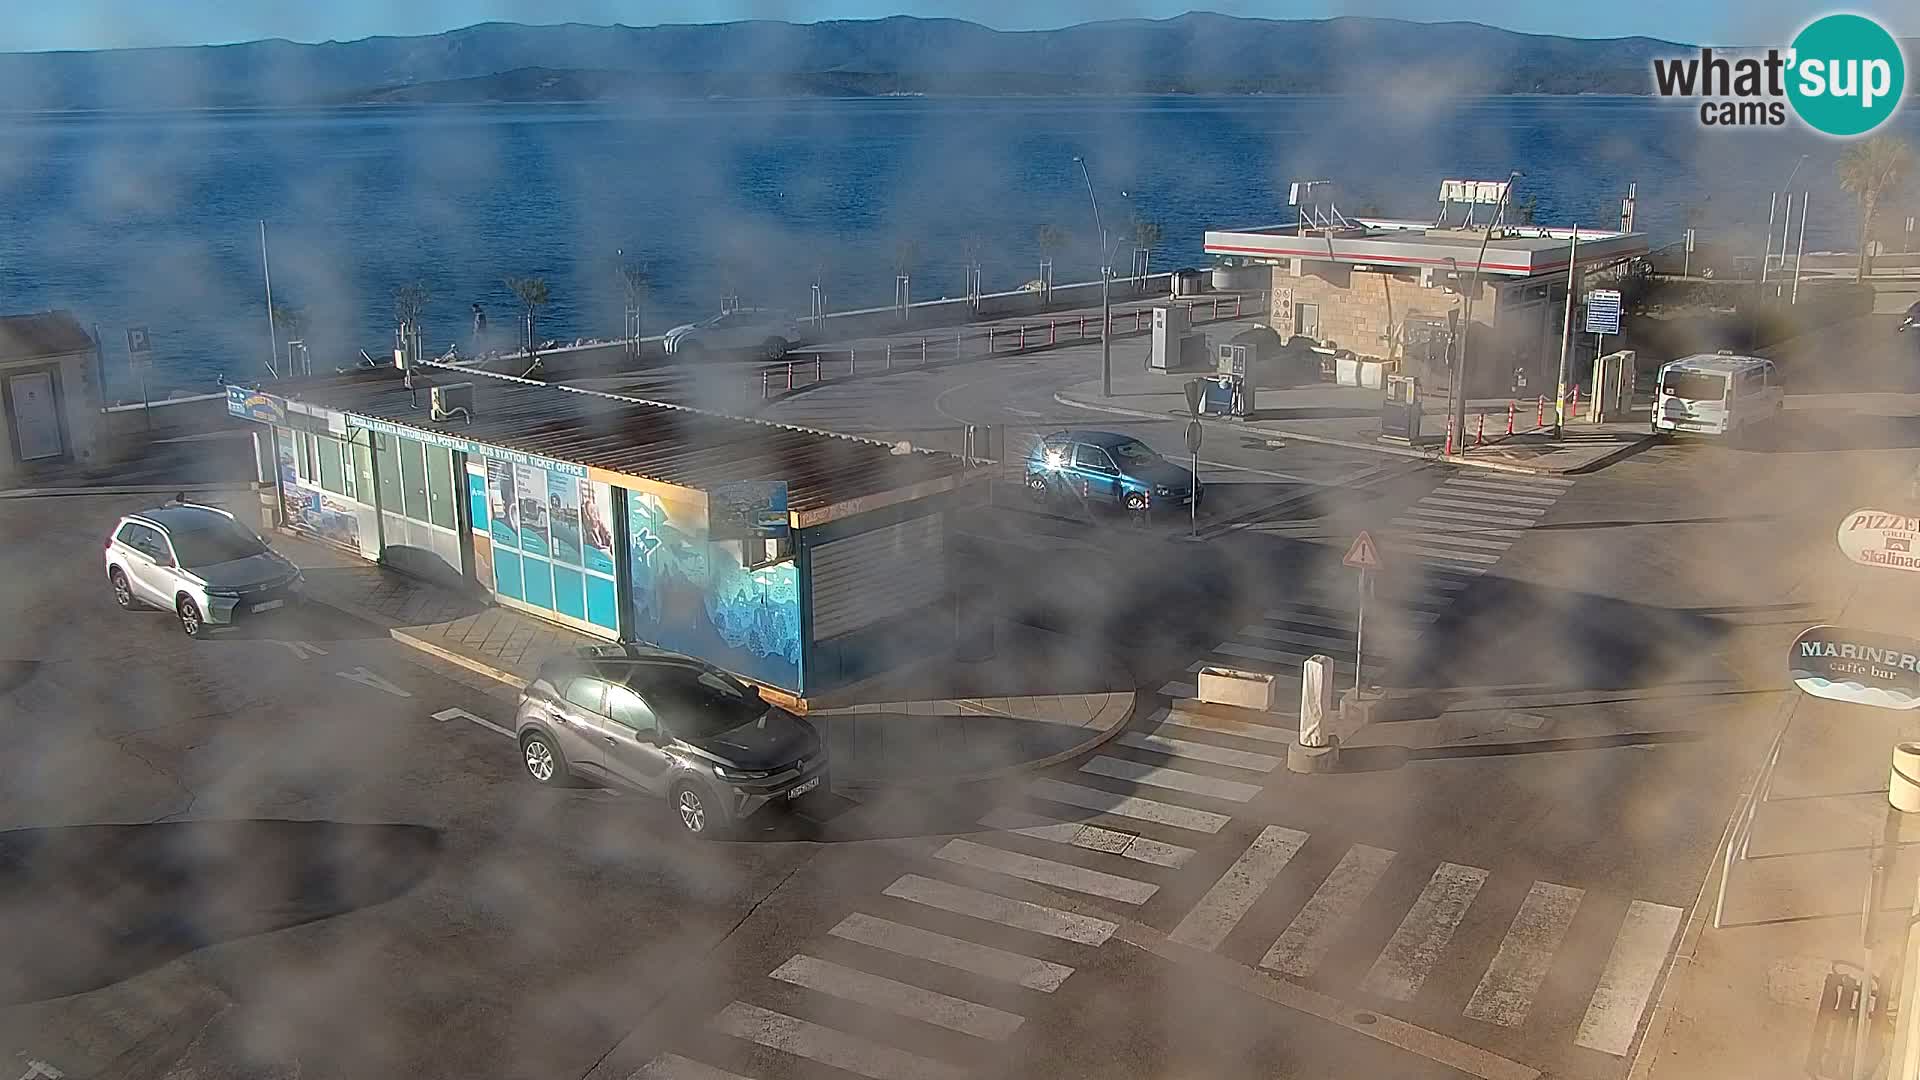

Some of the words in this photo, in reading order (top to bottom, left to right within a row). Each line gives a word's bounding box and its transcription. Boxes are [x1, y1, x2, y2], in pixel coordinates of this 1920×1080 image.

[132, 331, 144, 350] P
[437, 435, 469, 452] POSTAJA
[480, 445, 494, 457] BUS
[495, 448, 527, 464] STATION
[529, 456, 555, 470] TICKET
[556, 460, 583, 476] OFFICE
[1849, 515, 1920, 532] PIZZE
[1830, 662, 1866, 675] caffe
[1871, 665, 1897, 680] bar
